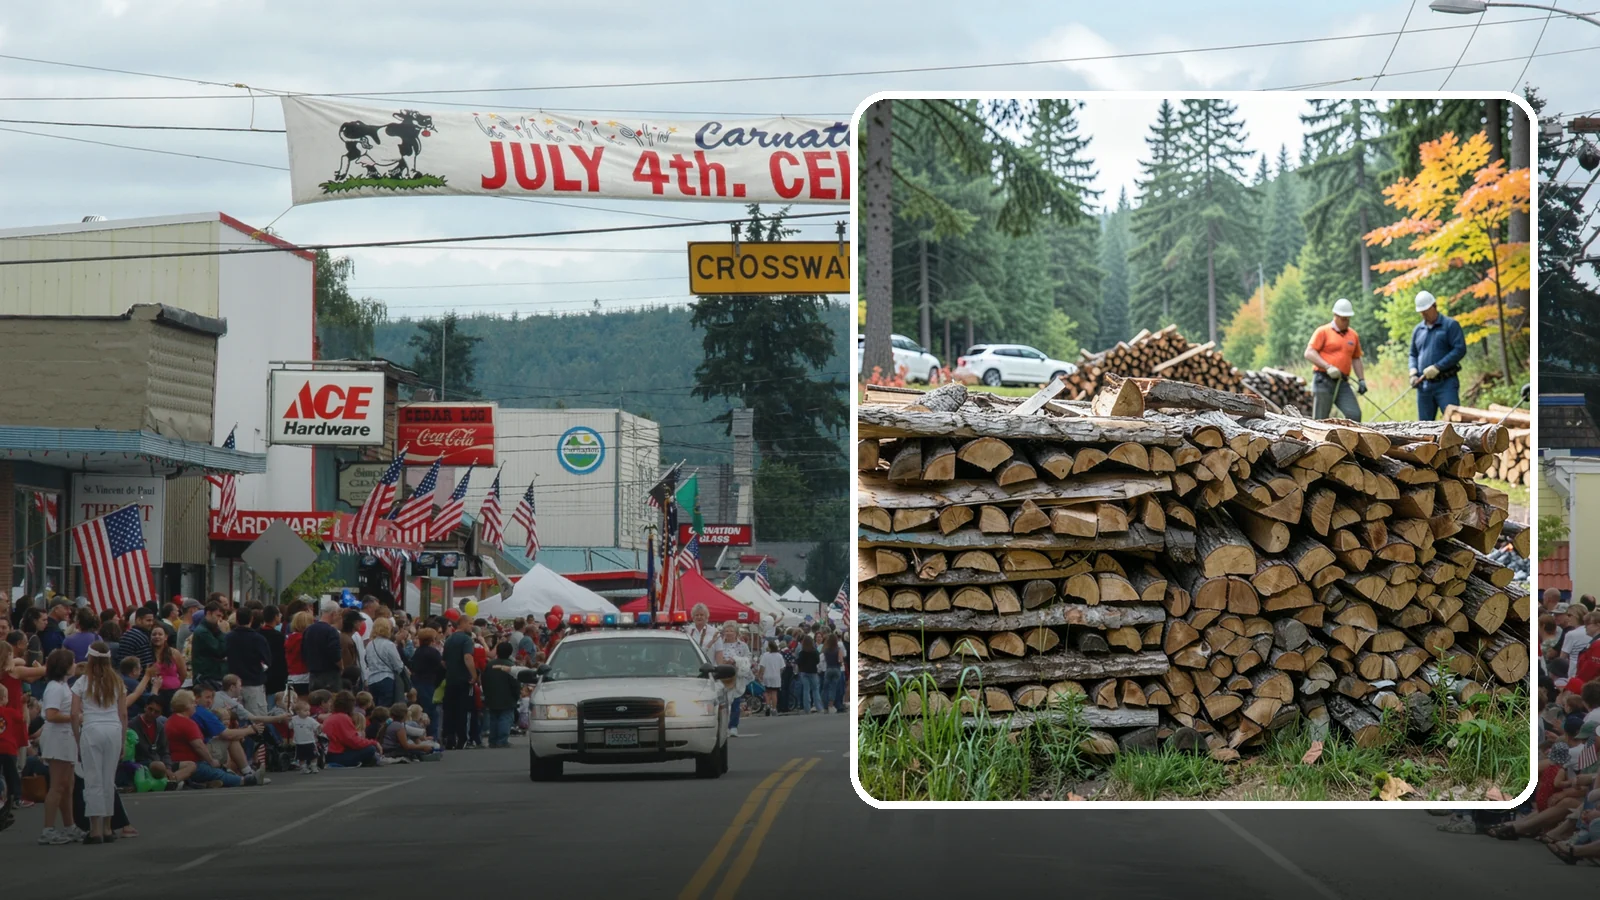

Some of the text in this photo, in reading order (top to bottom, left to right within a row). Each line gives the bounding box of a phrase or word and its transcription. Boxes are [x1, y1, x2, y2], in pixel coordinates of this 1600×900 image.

[481, 140, 605, 195] JULY
[631, 150, 746, 198] 4th.
[696, 254, 850, 280] CROSSWA
[282, 379, 374, 420] ACE
[405, 408, 485, 422] CEDAR LOG
[283, 421, 371, 437] Hardware
[416, 428, 477, 447] Coca-Cola
[353, 467, 385, 480] Simpl
[83, 485, 155, 496] St. Vincent de Paul
[688, 526, 742, 536] CRNATION
[699, 535, 731, 544] GLASS
